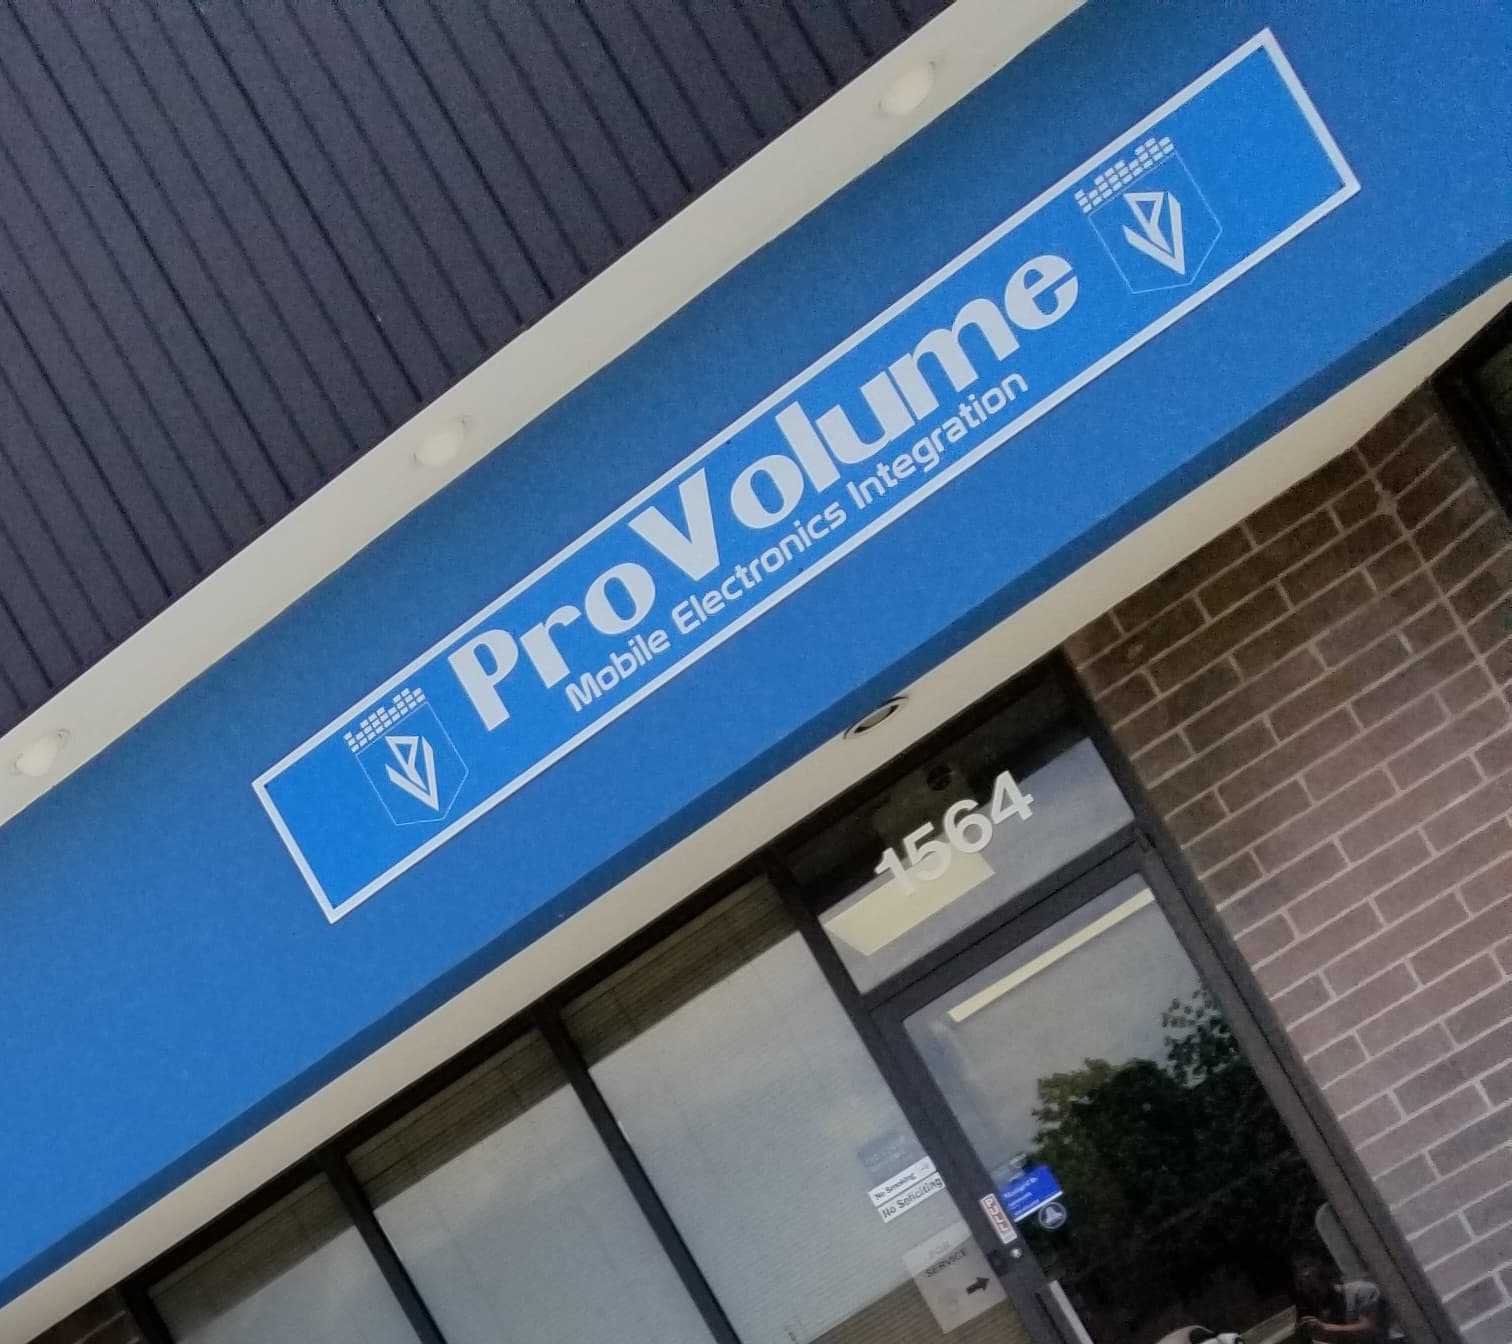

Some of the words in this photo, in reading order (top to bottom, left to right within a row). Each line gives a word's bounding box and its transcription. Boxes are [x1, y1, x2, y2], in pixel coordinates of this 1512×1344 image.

[447, 254, 1079, 732] ProVolume
[565, 629, 671, 712] Mobile
[671, 501, 847, 635] Electronics
[846, 373, 1028, 510] Integration
[875, 771, 1035, 898] 1564
[874, 1191, 886, 1201] No
[881, 1205, 896, 1219] No
[986, 1198, 1009, 1232] PULL
[925, 1248, 967, 1278] SERVICE
